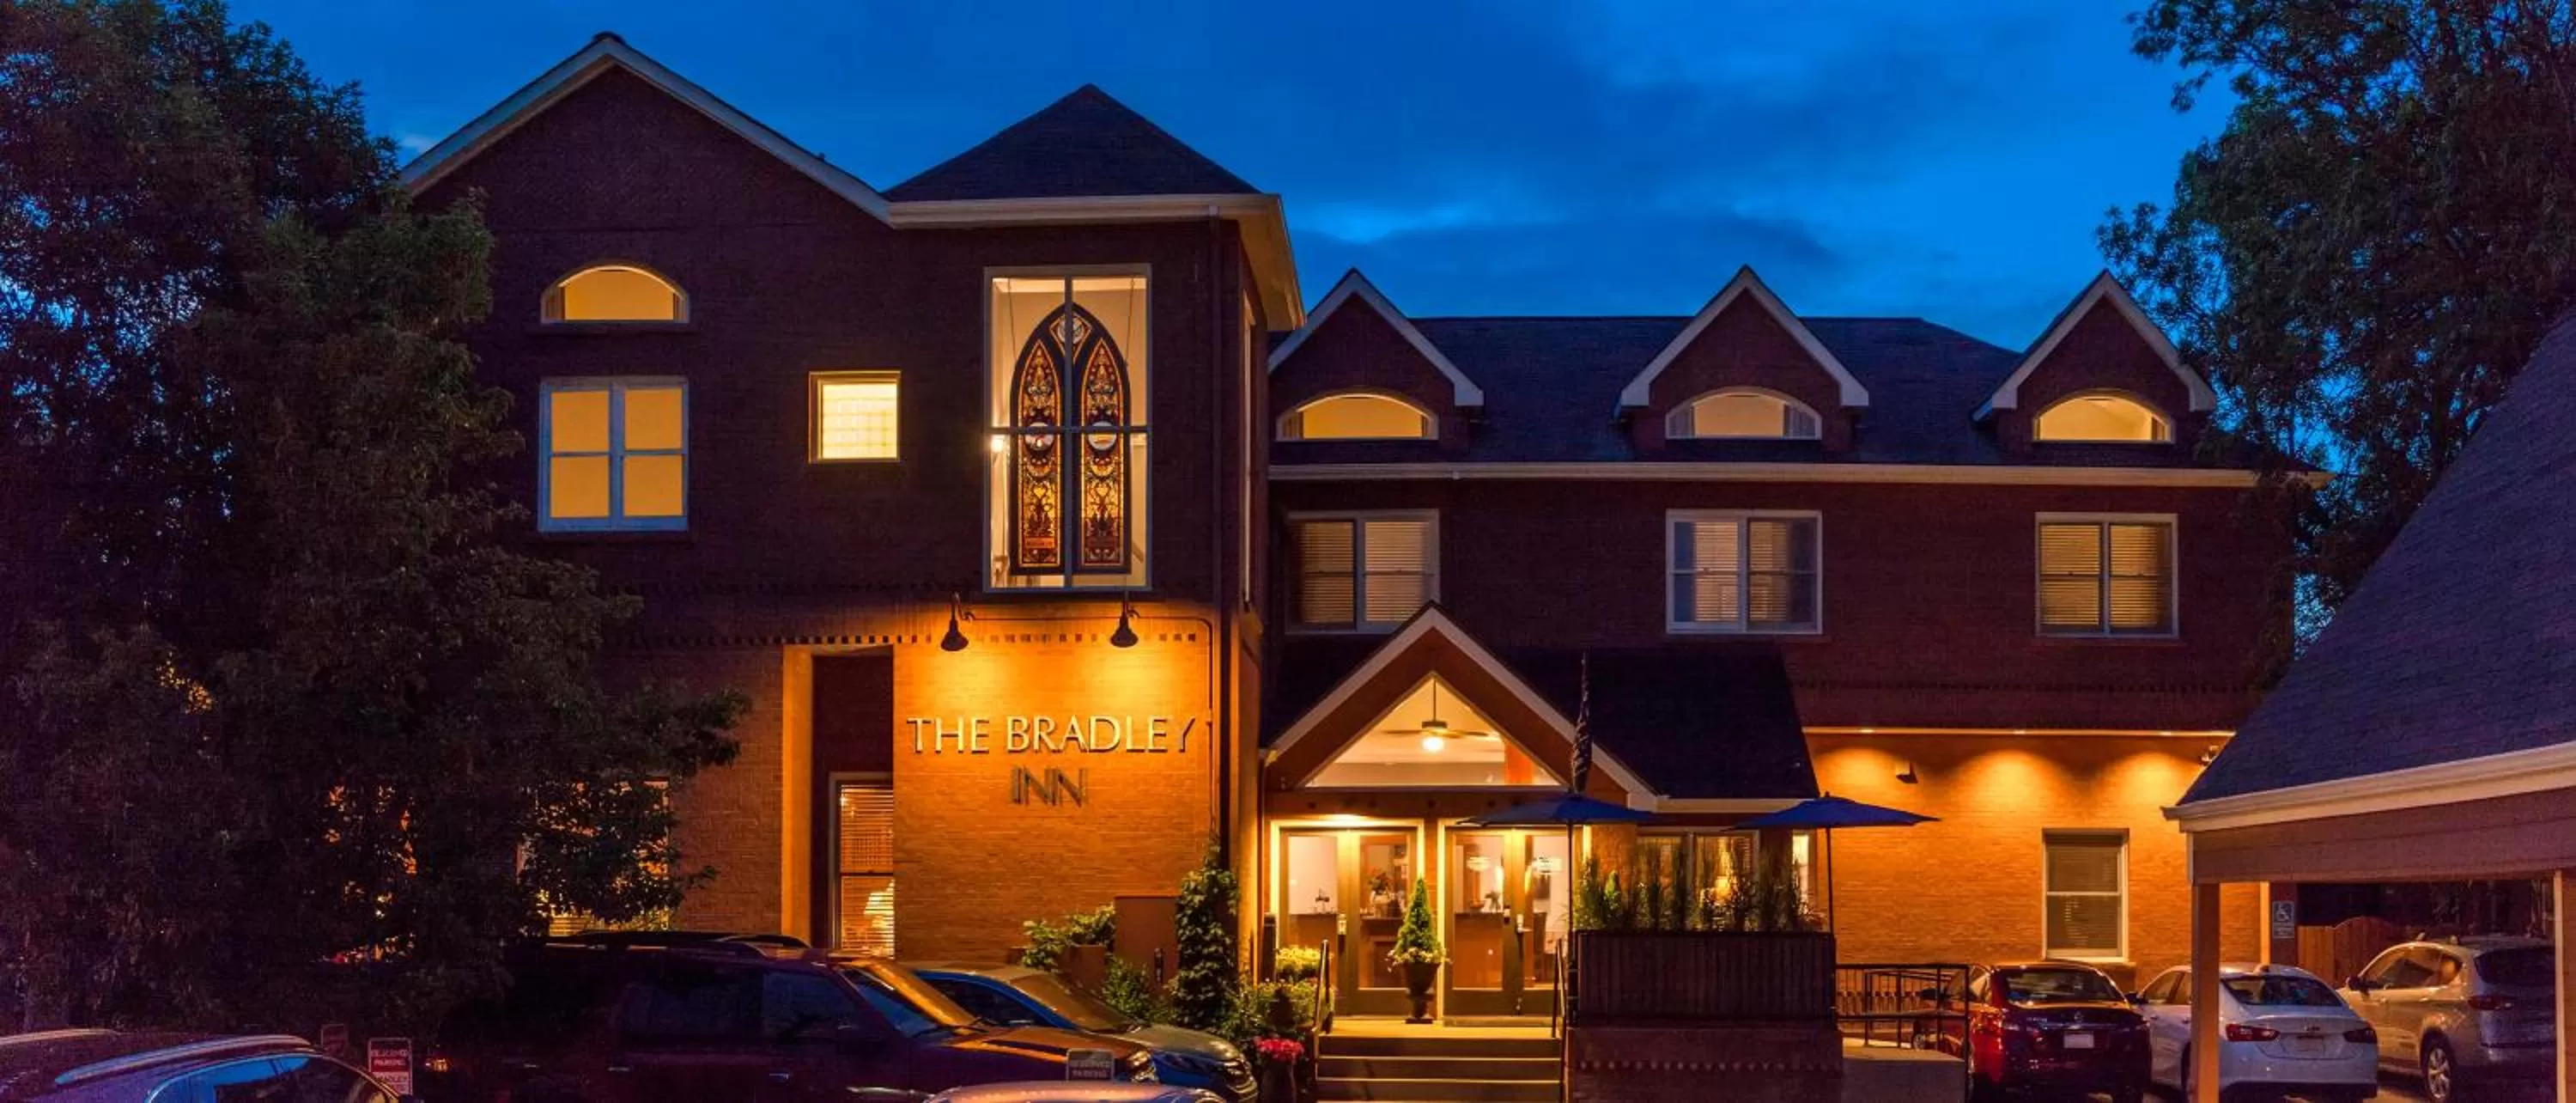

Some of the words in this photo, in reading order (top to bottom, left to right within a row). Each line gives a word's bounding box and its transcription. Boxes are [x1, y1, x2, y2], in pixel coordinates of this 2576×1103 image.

[907, 716, 990, 754] THE
[1005, 715, 1196, 753] BRADLEY
[1012, 765, 1087, 807] INN
